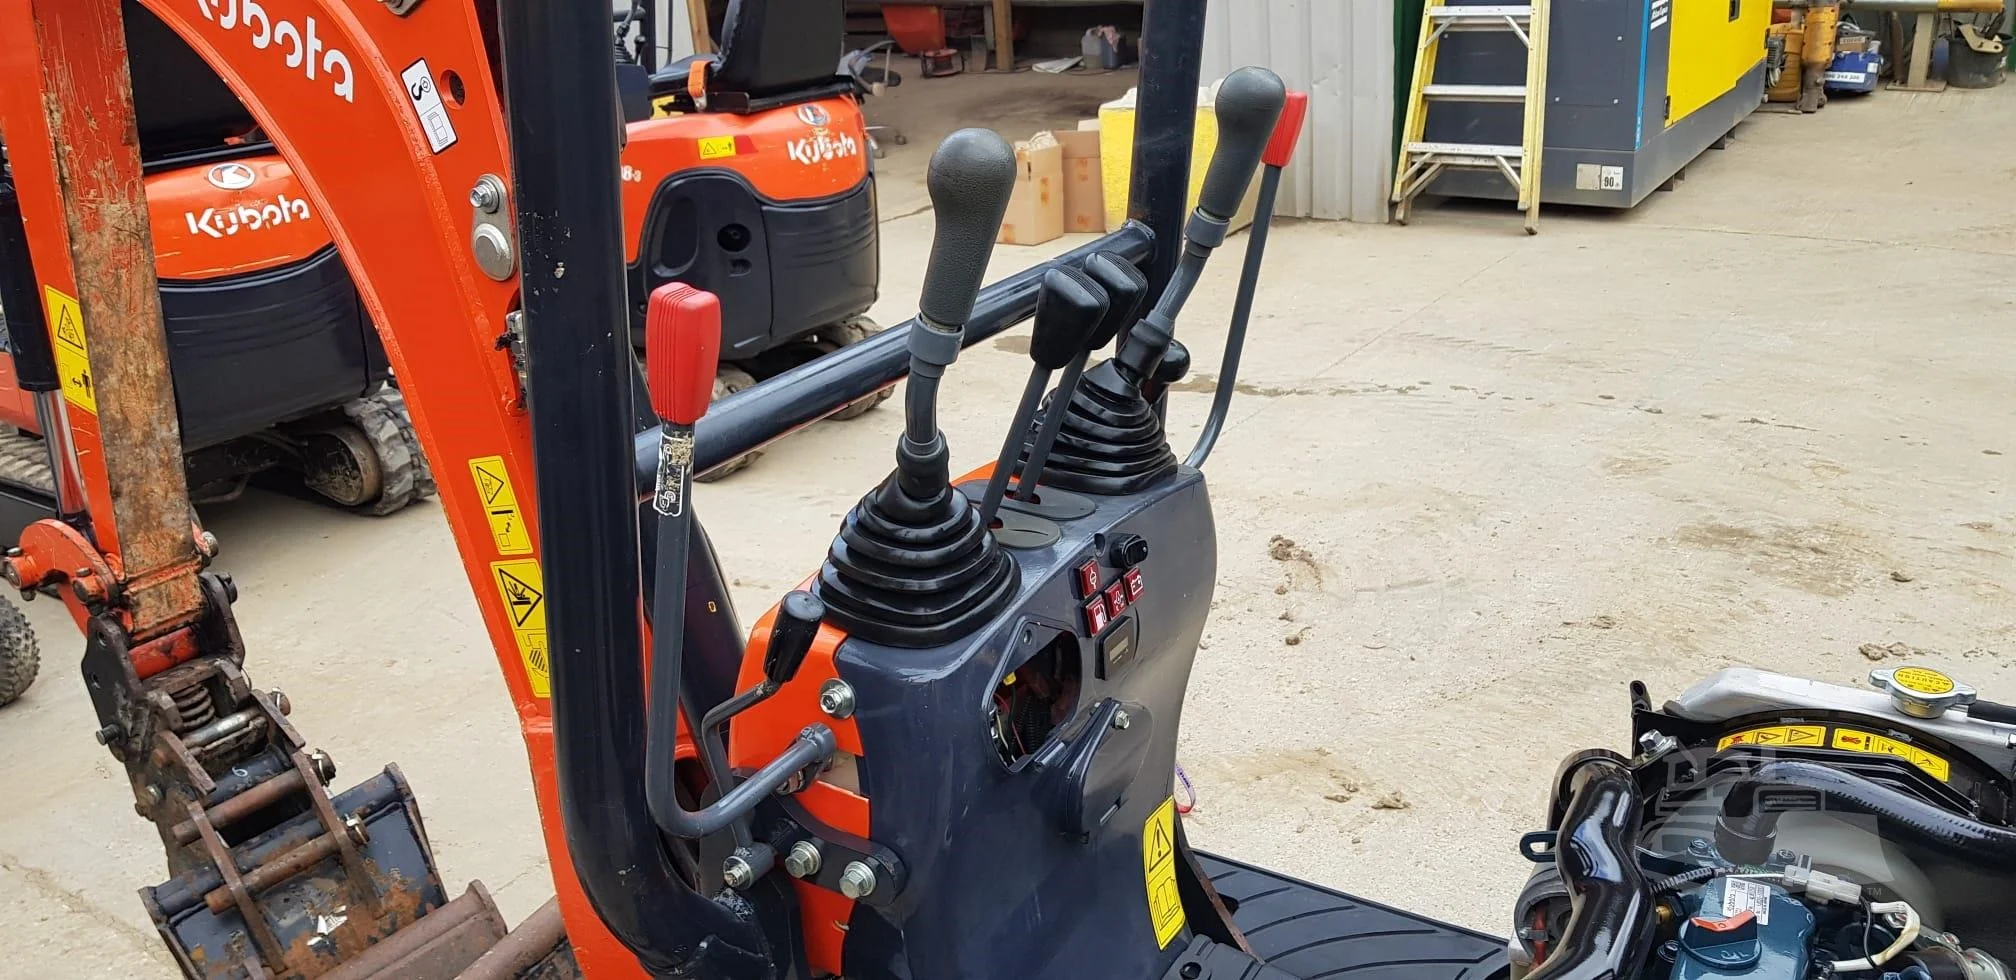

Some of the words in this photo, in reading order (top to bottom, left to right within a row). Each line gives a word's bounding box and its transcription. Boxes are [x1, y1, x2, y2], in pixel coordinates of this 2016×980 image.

[197, 0, 353, 103] ubota
[787, 132, 857, 165] Kubota
[185, 194, 310, 238] Kubota
